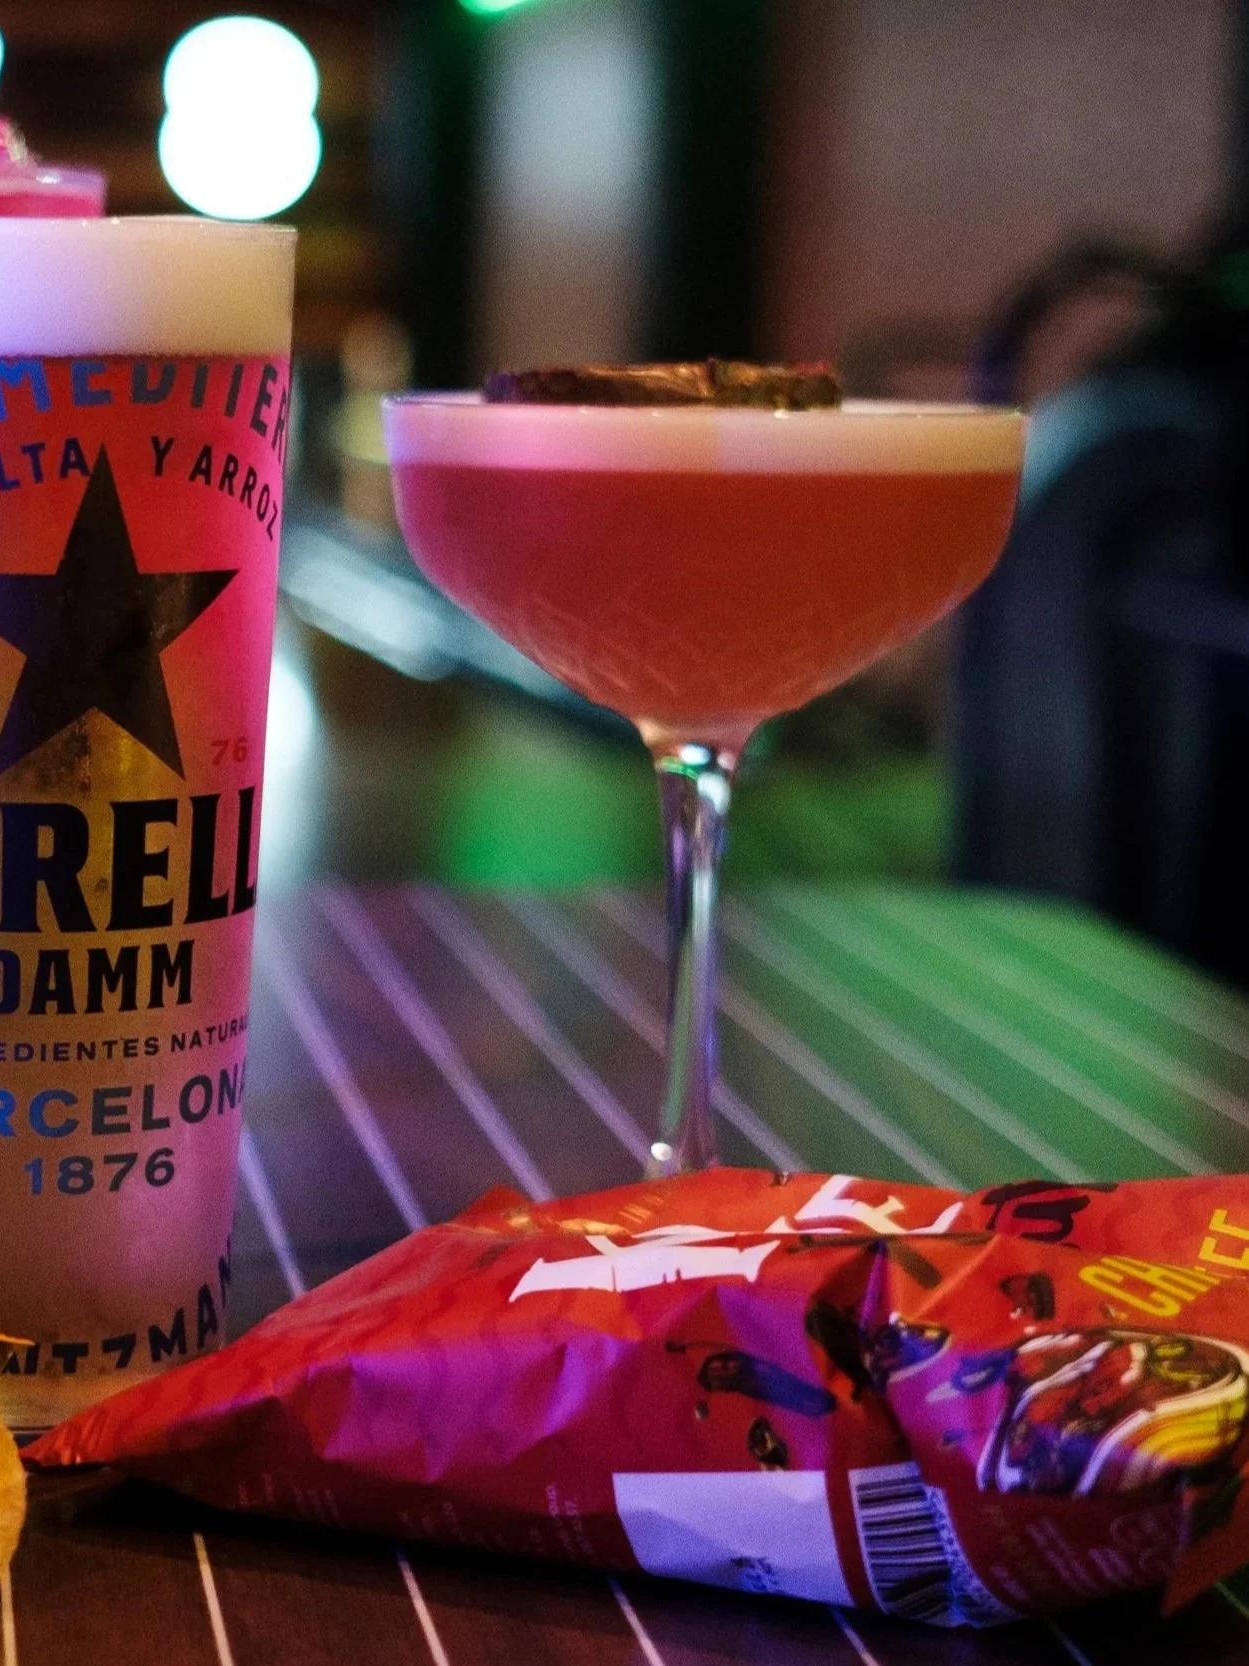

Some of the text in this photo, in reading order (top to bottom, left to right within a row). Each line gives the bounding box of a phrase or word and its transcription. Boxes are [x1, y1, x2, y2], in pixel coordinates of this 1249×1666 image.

[158, 15, 322, 221] 8
[150, 434, 175, 478] Y
[187, 443, 279, 543] ARROZ
[210, 736, 249, 767] 76
[24, 1147, 176, 1196] 1876
